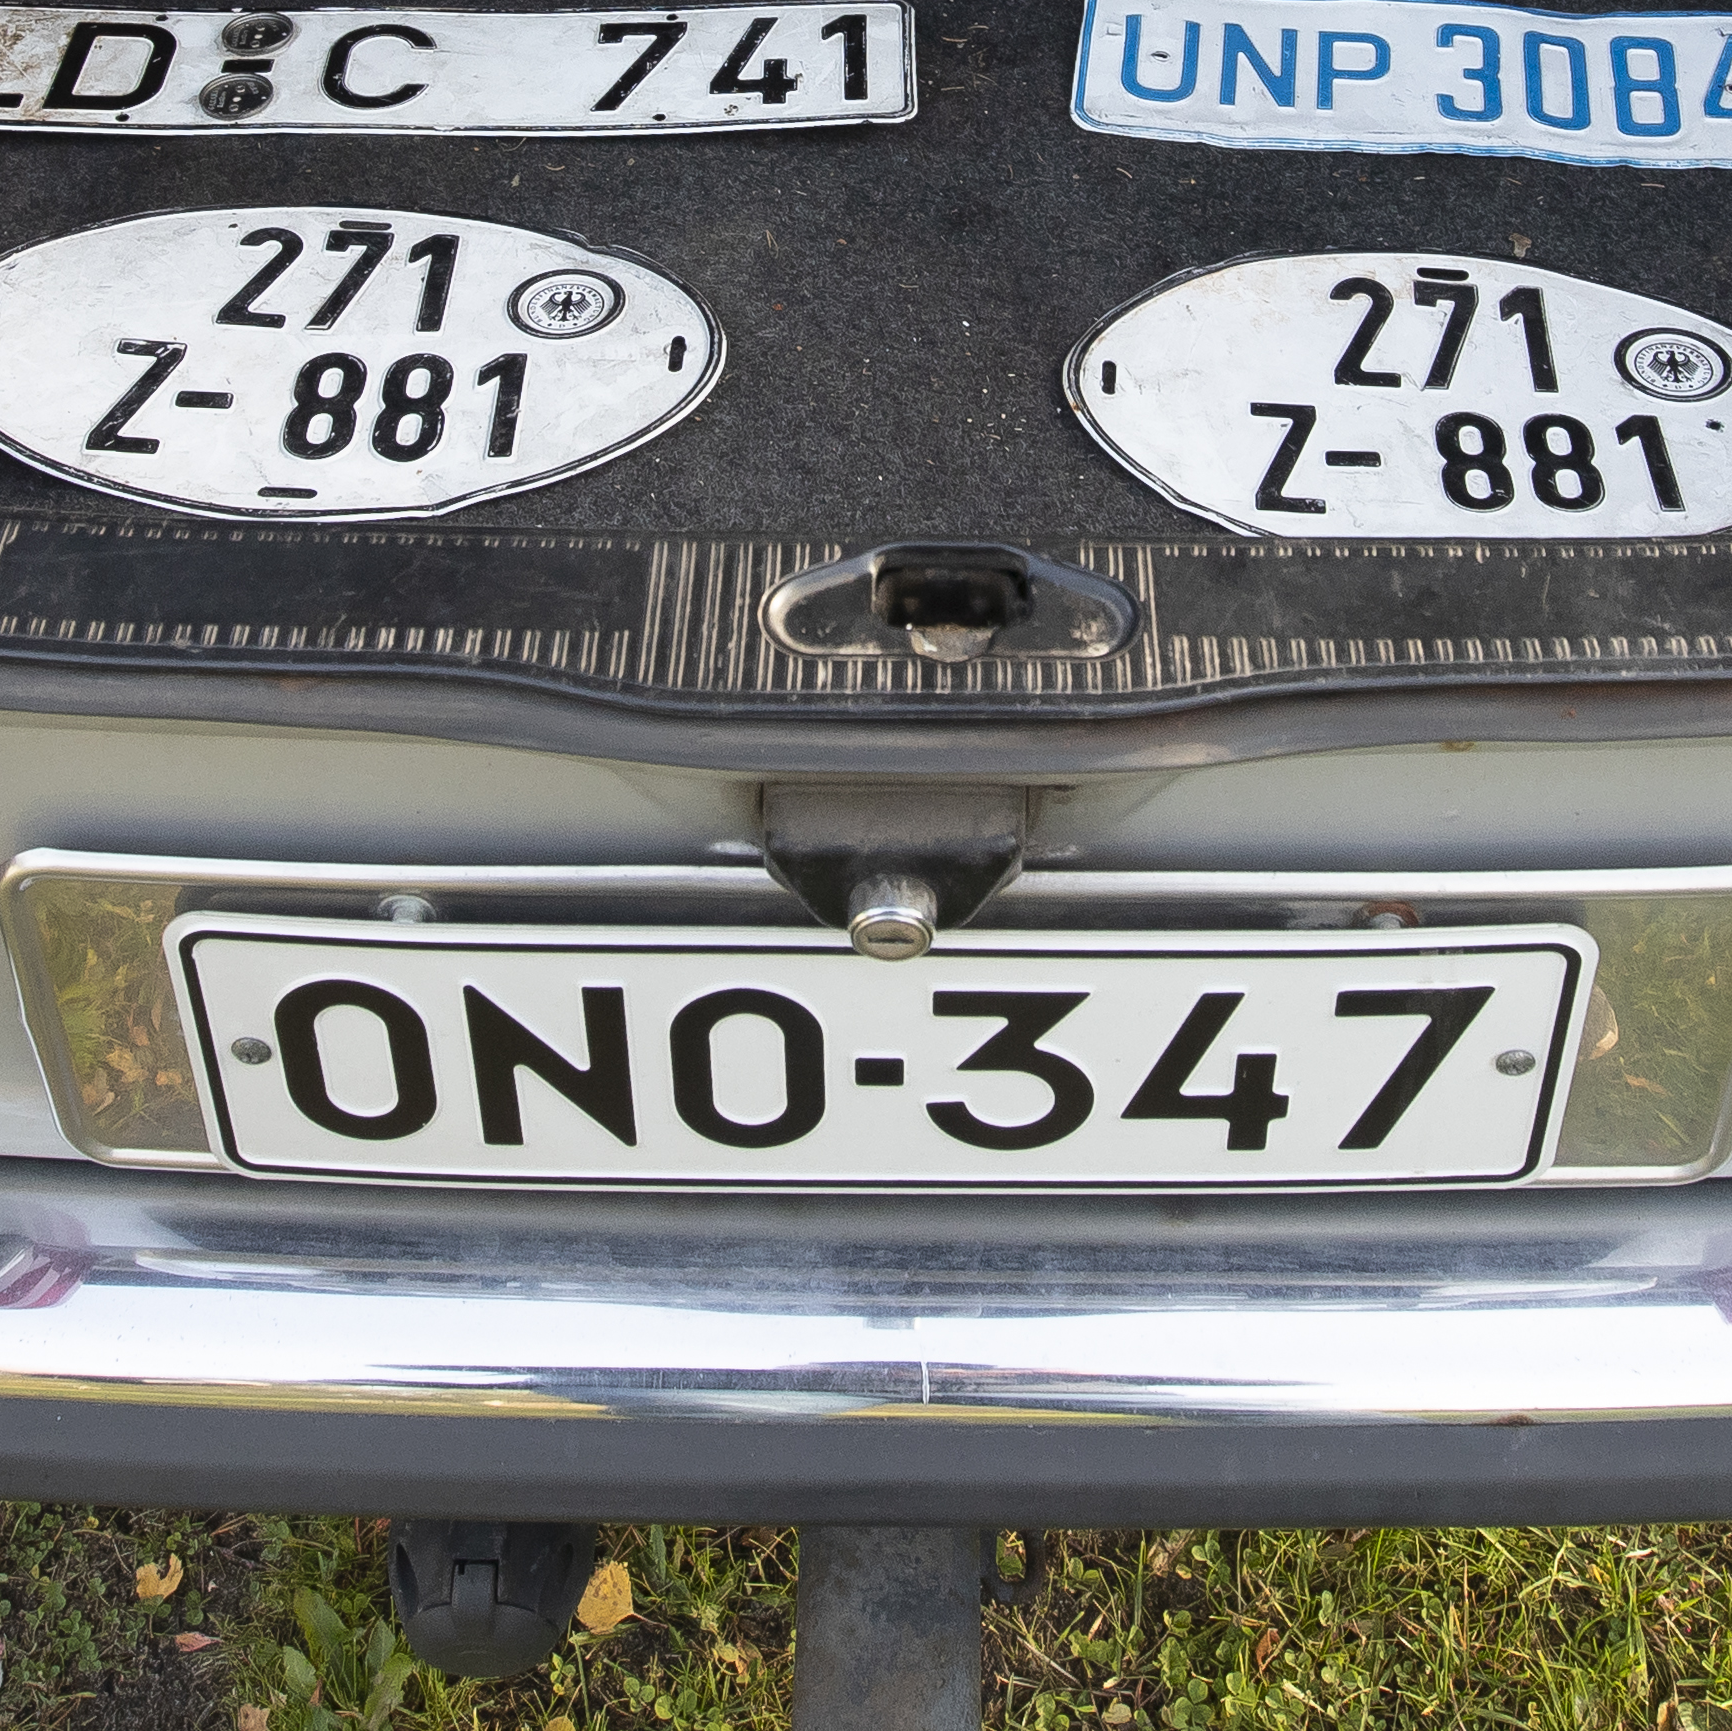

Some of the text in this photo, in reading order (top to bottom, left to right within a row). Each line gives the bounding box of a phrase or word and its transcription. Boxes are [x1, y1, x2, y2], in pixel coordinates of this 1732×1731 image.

[589, 12, 870, 113] 741
[1121, 13, 1391, 111] UNP
[215, 227, 461, 333] 271
[1329, 276, 1559, 393] 271
[273, 978, 1495, 1152] ONO-347
